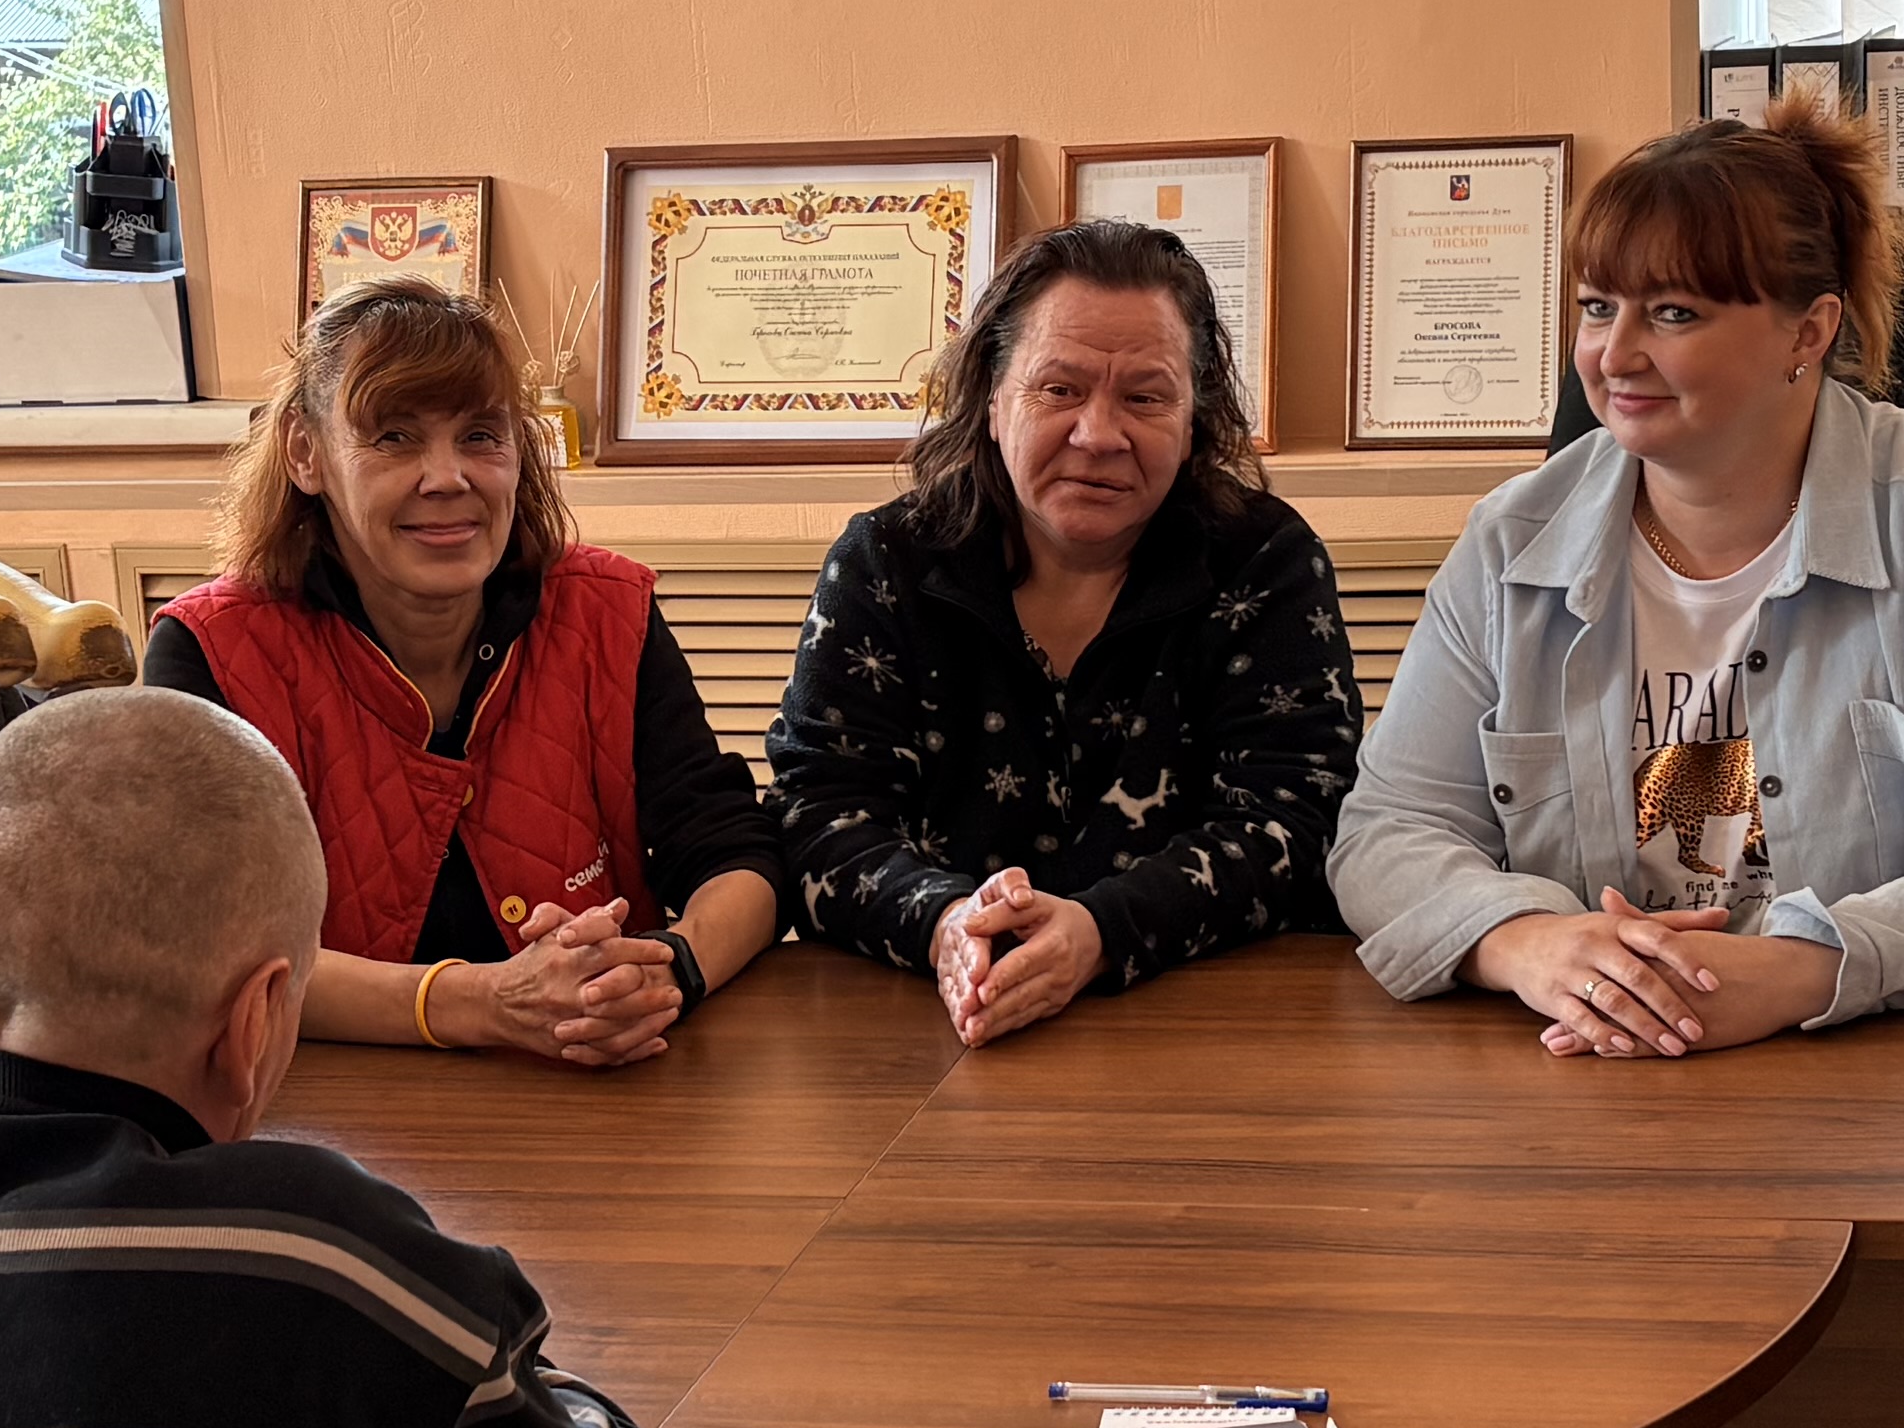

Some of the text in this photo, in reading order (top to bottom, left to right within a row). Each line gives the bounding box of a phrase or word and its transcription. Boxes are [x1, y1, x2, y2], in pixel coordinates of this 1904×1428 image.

[1391, 224, 1530, 238] БЛАГОДАРСТВЕННОЕ
[1432, 237, 1488, 249] ПИСЬМО
[735, 267, 874, 282] ПОЧЕТНАЯ ГРАМОТА
[1685, 879, 1715, 893] find
